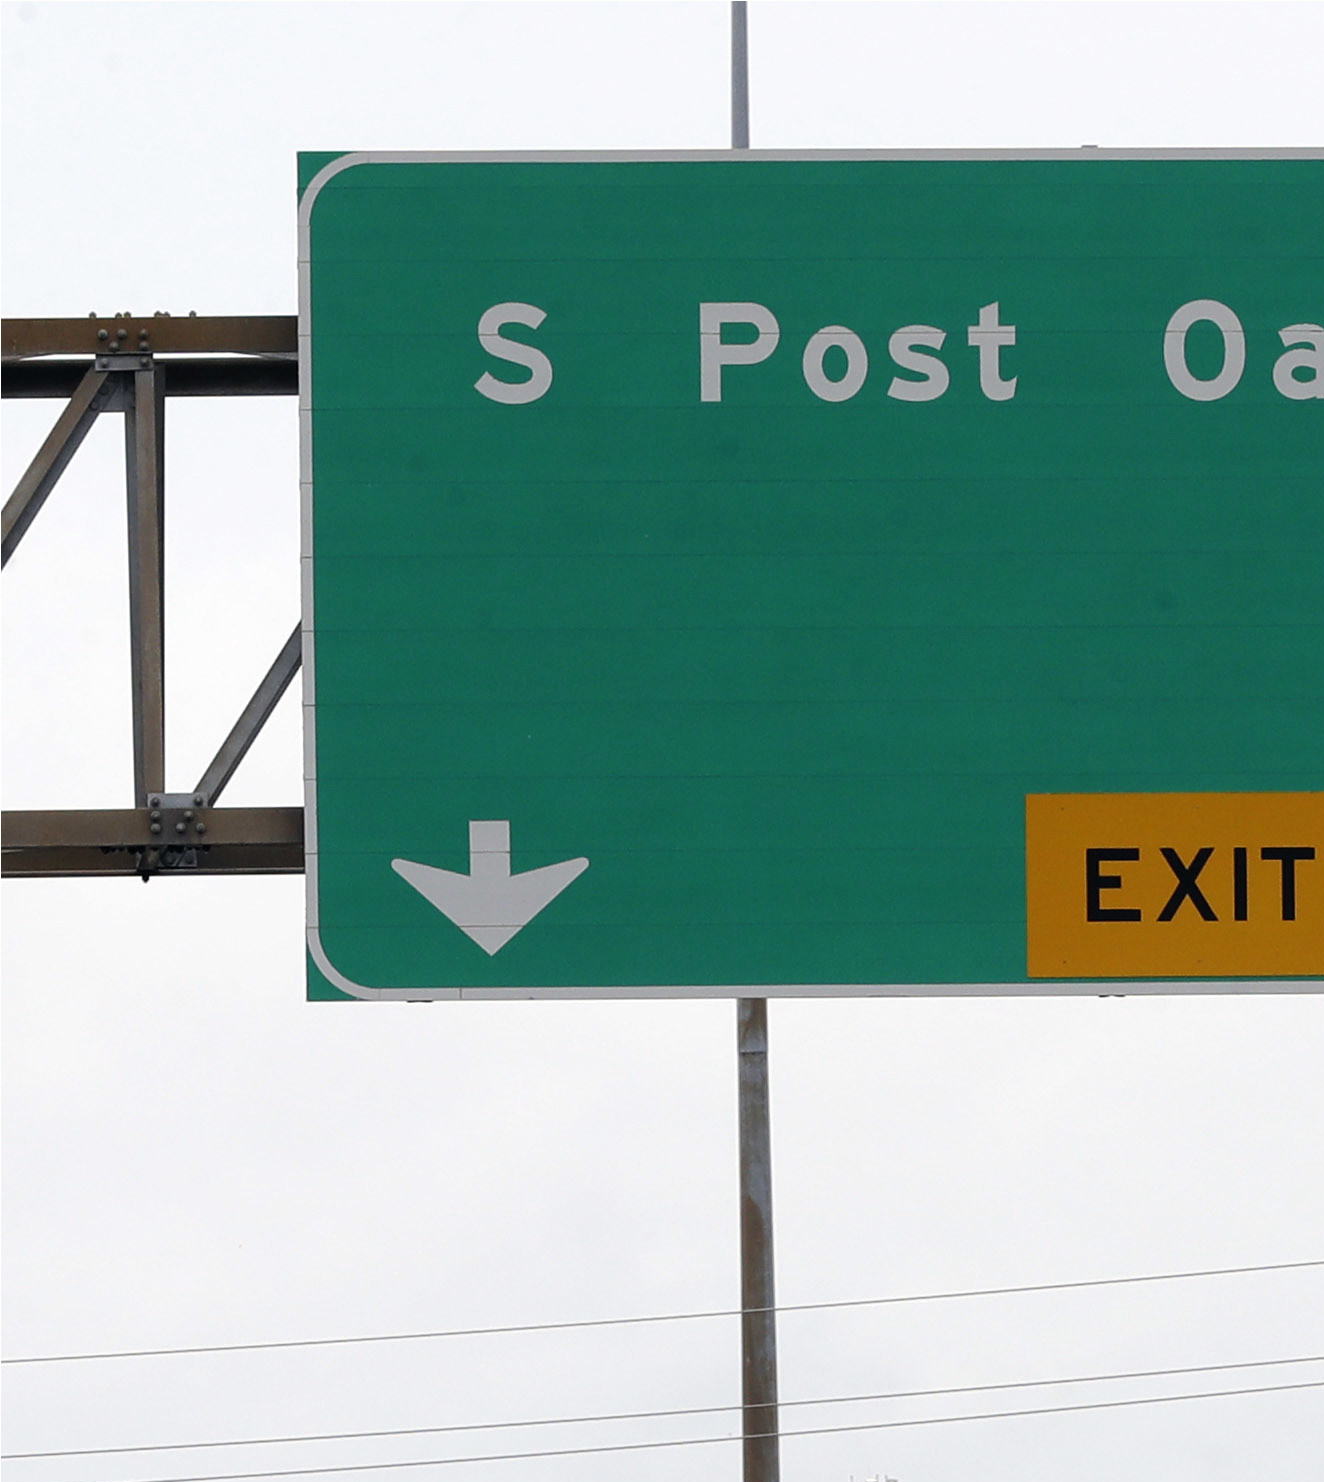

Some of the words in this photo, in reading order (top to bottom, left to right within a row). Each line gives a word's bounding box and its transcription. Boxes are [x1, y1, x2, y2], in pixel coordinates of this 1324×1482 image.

[474, 301, 553, 405] S
[699, 301, 1018, 403] Post
[1085, 846, 1316, 923] EXIT
